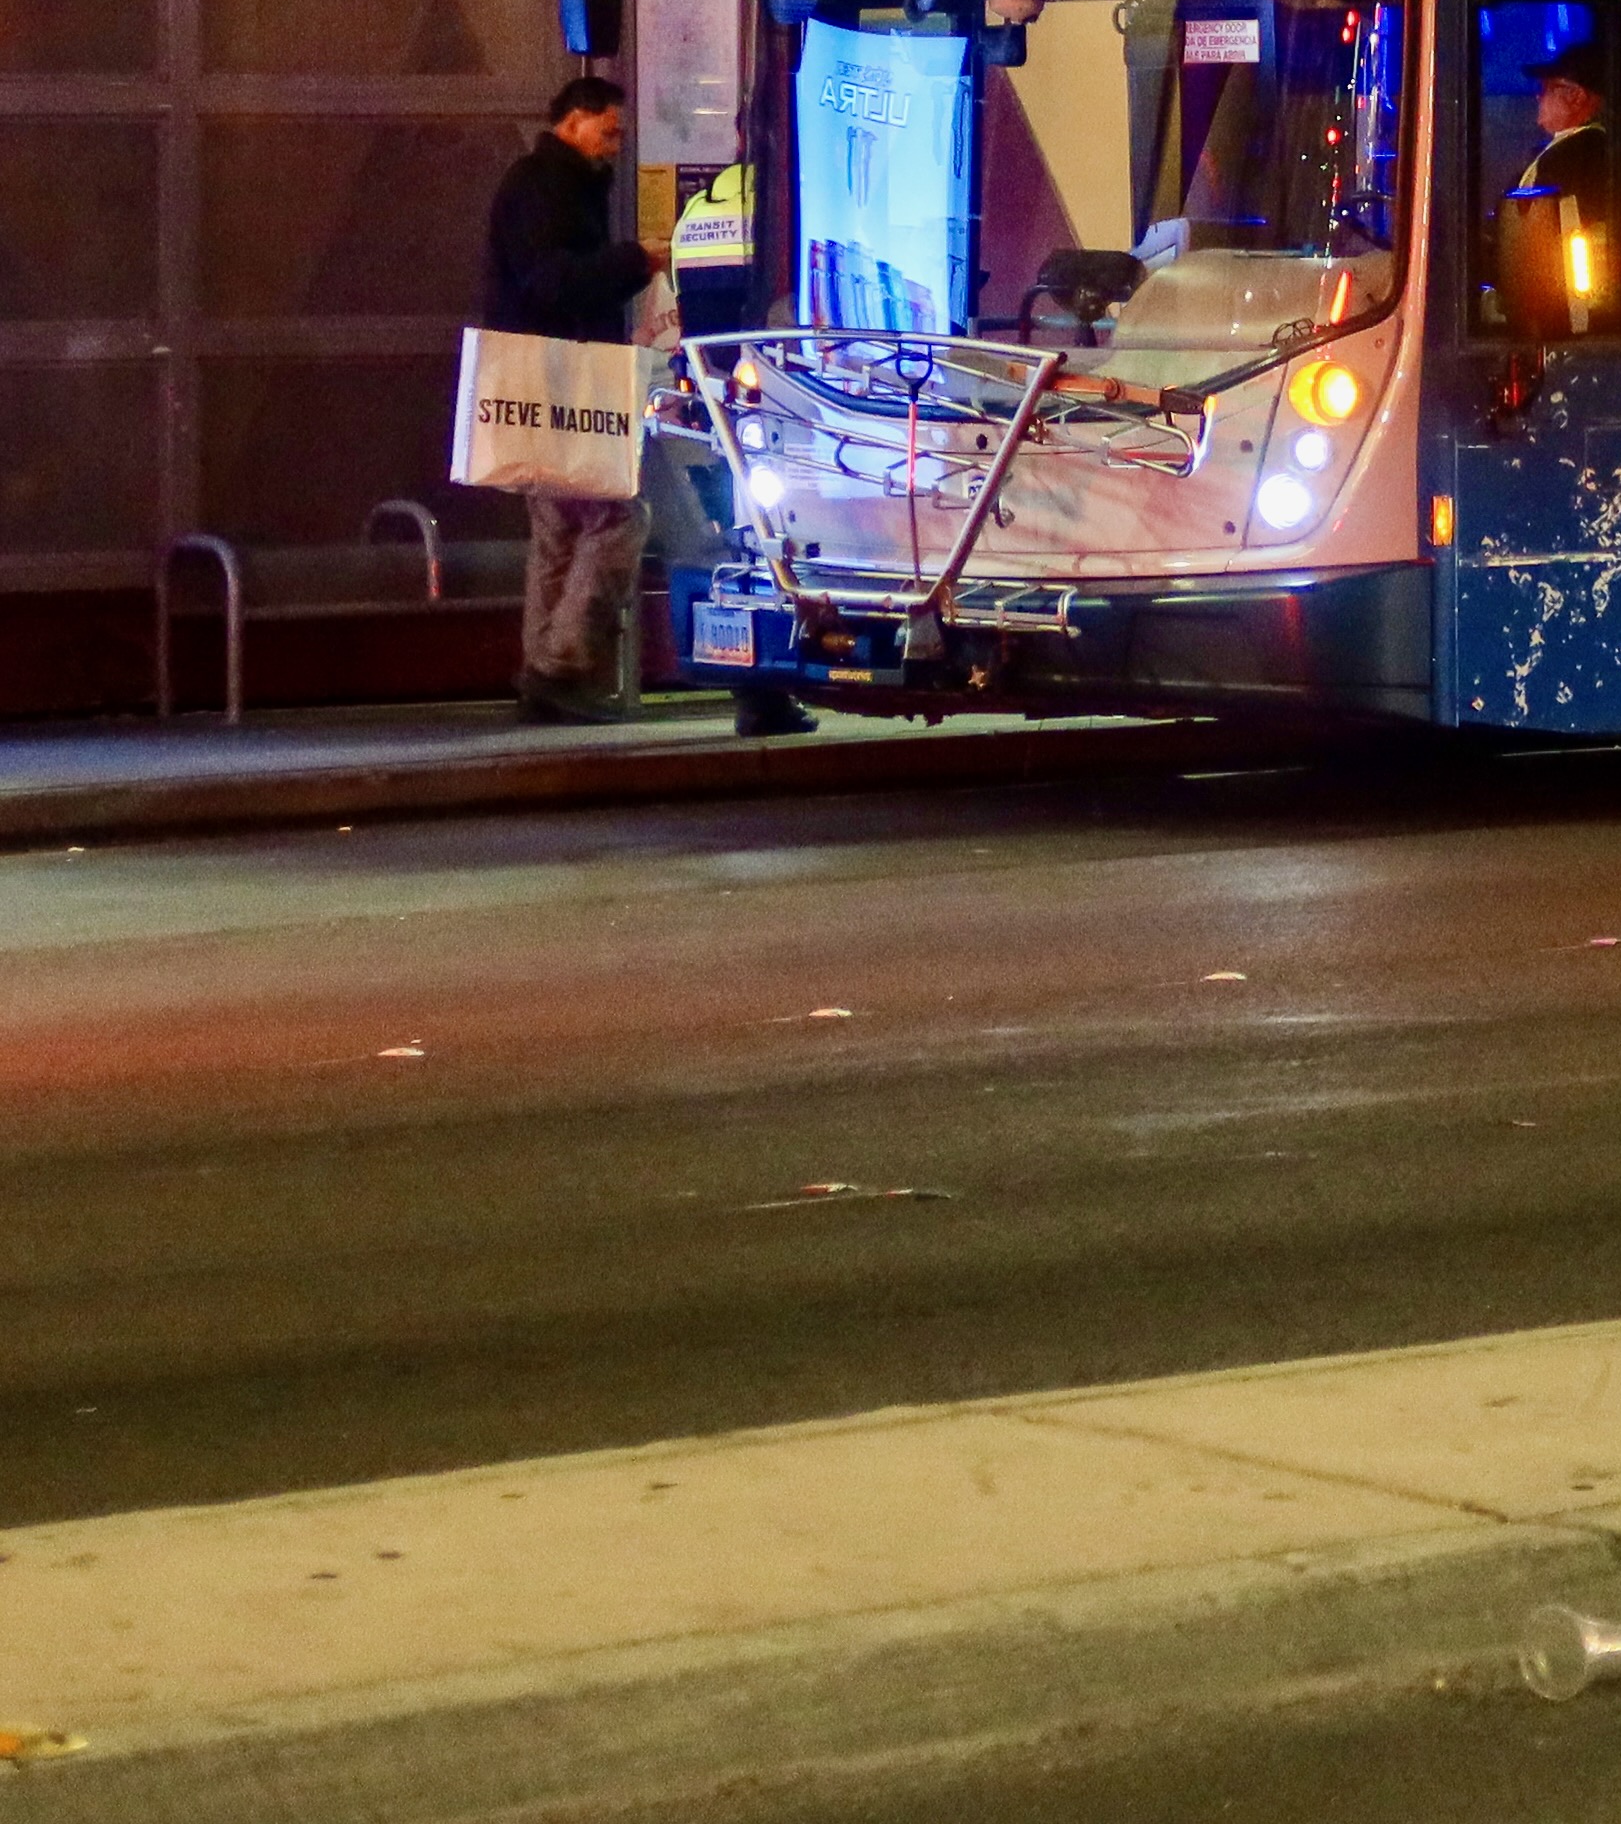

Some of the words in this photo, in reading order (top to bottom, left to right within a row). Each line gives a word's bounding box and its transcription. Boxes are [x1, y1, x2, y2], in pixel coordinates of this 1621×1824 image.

[685, 219, 735, 232] TRANSIT
[679, 229, 738, 244] SECURITY
[477, 398, 542, 429] STEVE
[550, 403, 630, 438] MADDEN
